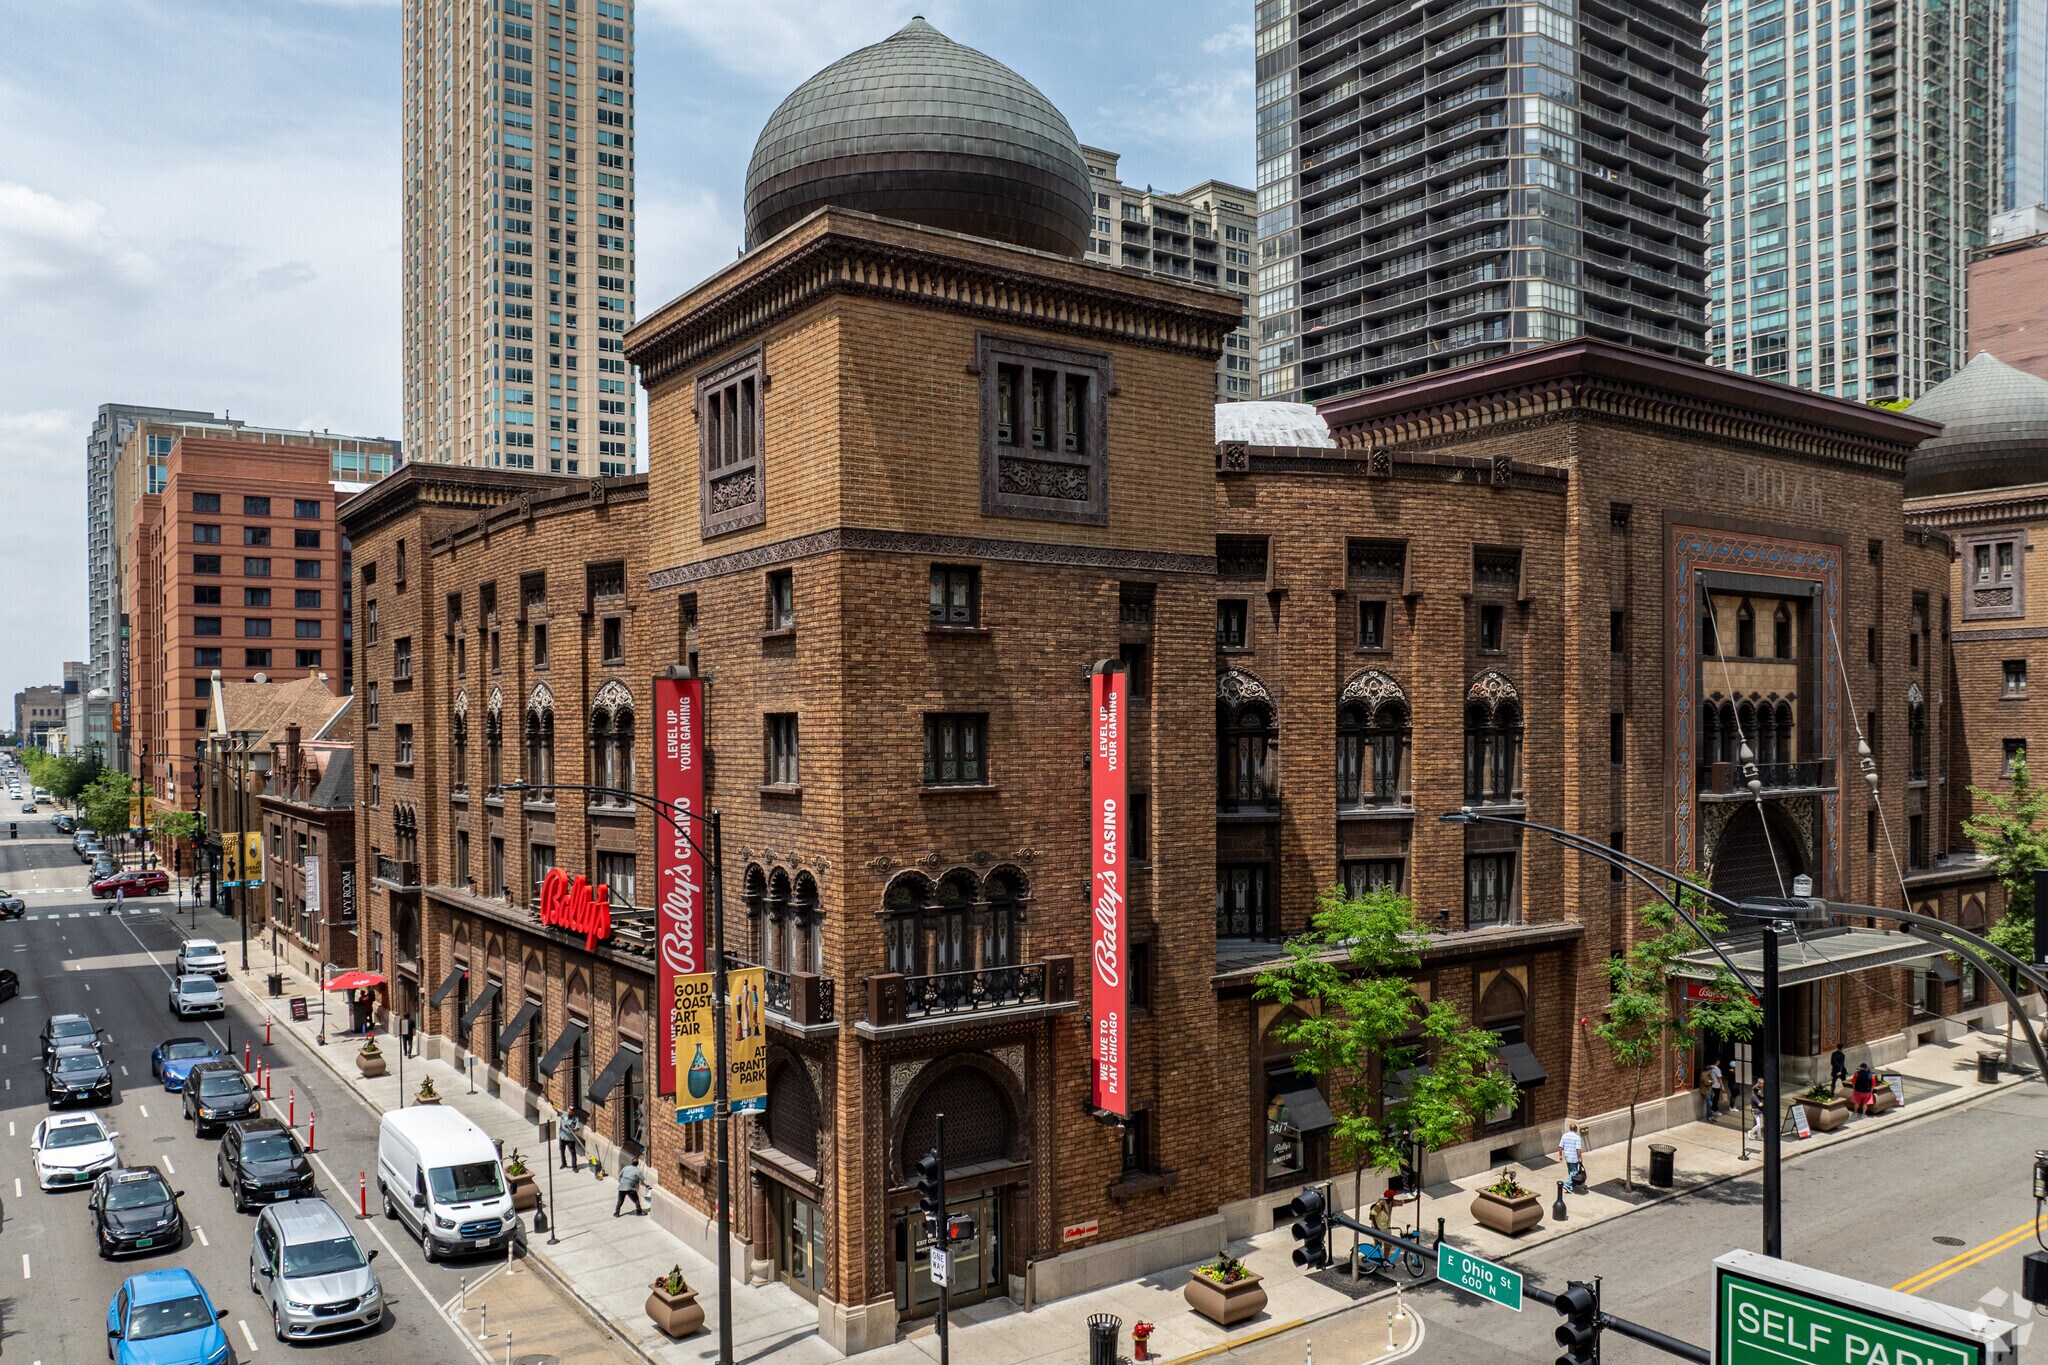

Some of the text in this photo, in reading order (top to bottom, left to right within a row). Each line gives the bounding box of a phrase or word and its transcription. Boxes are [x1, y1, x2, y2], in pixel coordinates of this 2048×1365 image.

[667, 710, 678, 759] LEVEL UP
[680, 697, 691, 771] YOUR GAMING
[1100, 706, 1108, 757] LEVEL UP
[1109, 692, 1117, 771] YOUR GAMING
[342, 870, 351, 915] IVY ROOM
[662, 797, 700, 973] Bally's CASINO
[1094, 798, 1122, 987] Bally's CASINO
[540, 867, 611, 951] Bally's
[674, 982, 709, 997] GOLD
[674, 995, 712, 1010] COAST
[674, 1010, 697, 1023] ART
[675, 1023, 700, 1036] FAIR
[754, 1046, 766, 1058] AT
[1100, 1020, 1108, 1080] WE LIVE TO
[1109, 1012, 1117, 1093] PLAY CHICAGO
[731, 1058, 766, 1073] GRANT
[740, 1069, 765, 1084] PARK
[686, 1107, 704, 1115] JUNE
[932, 1251, 944, 1263] ONE
[932, 1260, 945, 1272] WAY
[1447, 1255, 1454, 1266] E
[1462, 1258, 1493, 1283] Ohio
[1462, 1274, 1496, 1296] 600 N
[1737, 1301, 1951, 1365] SELF PAR
